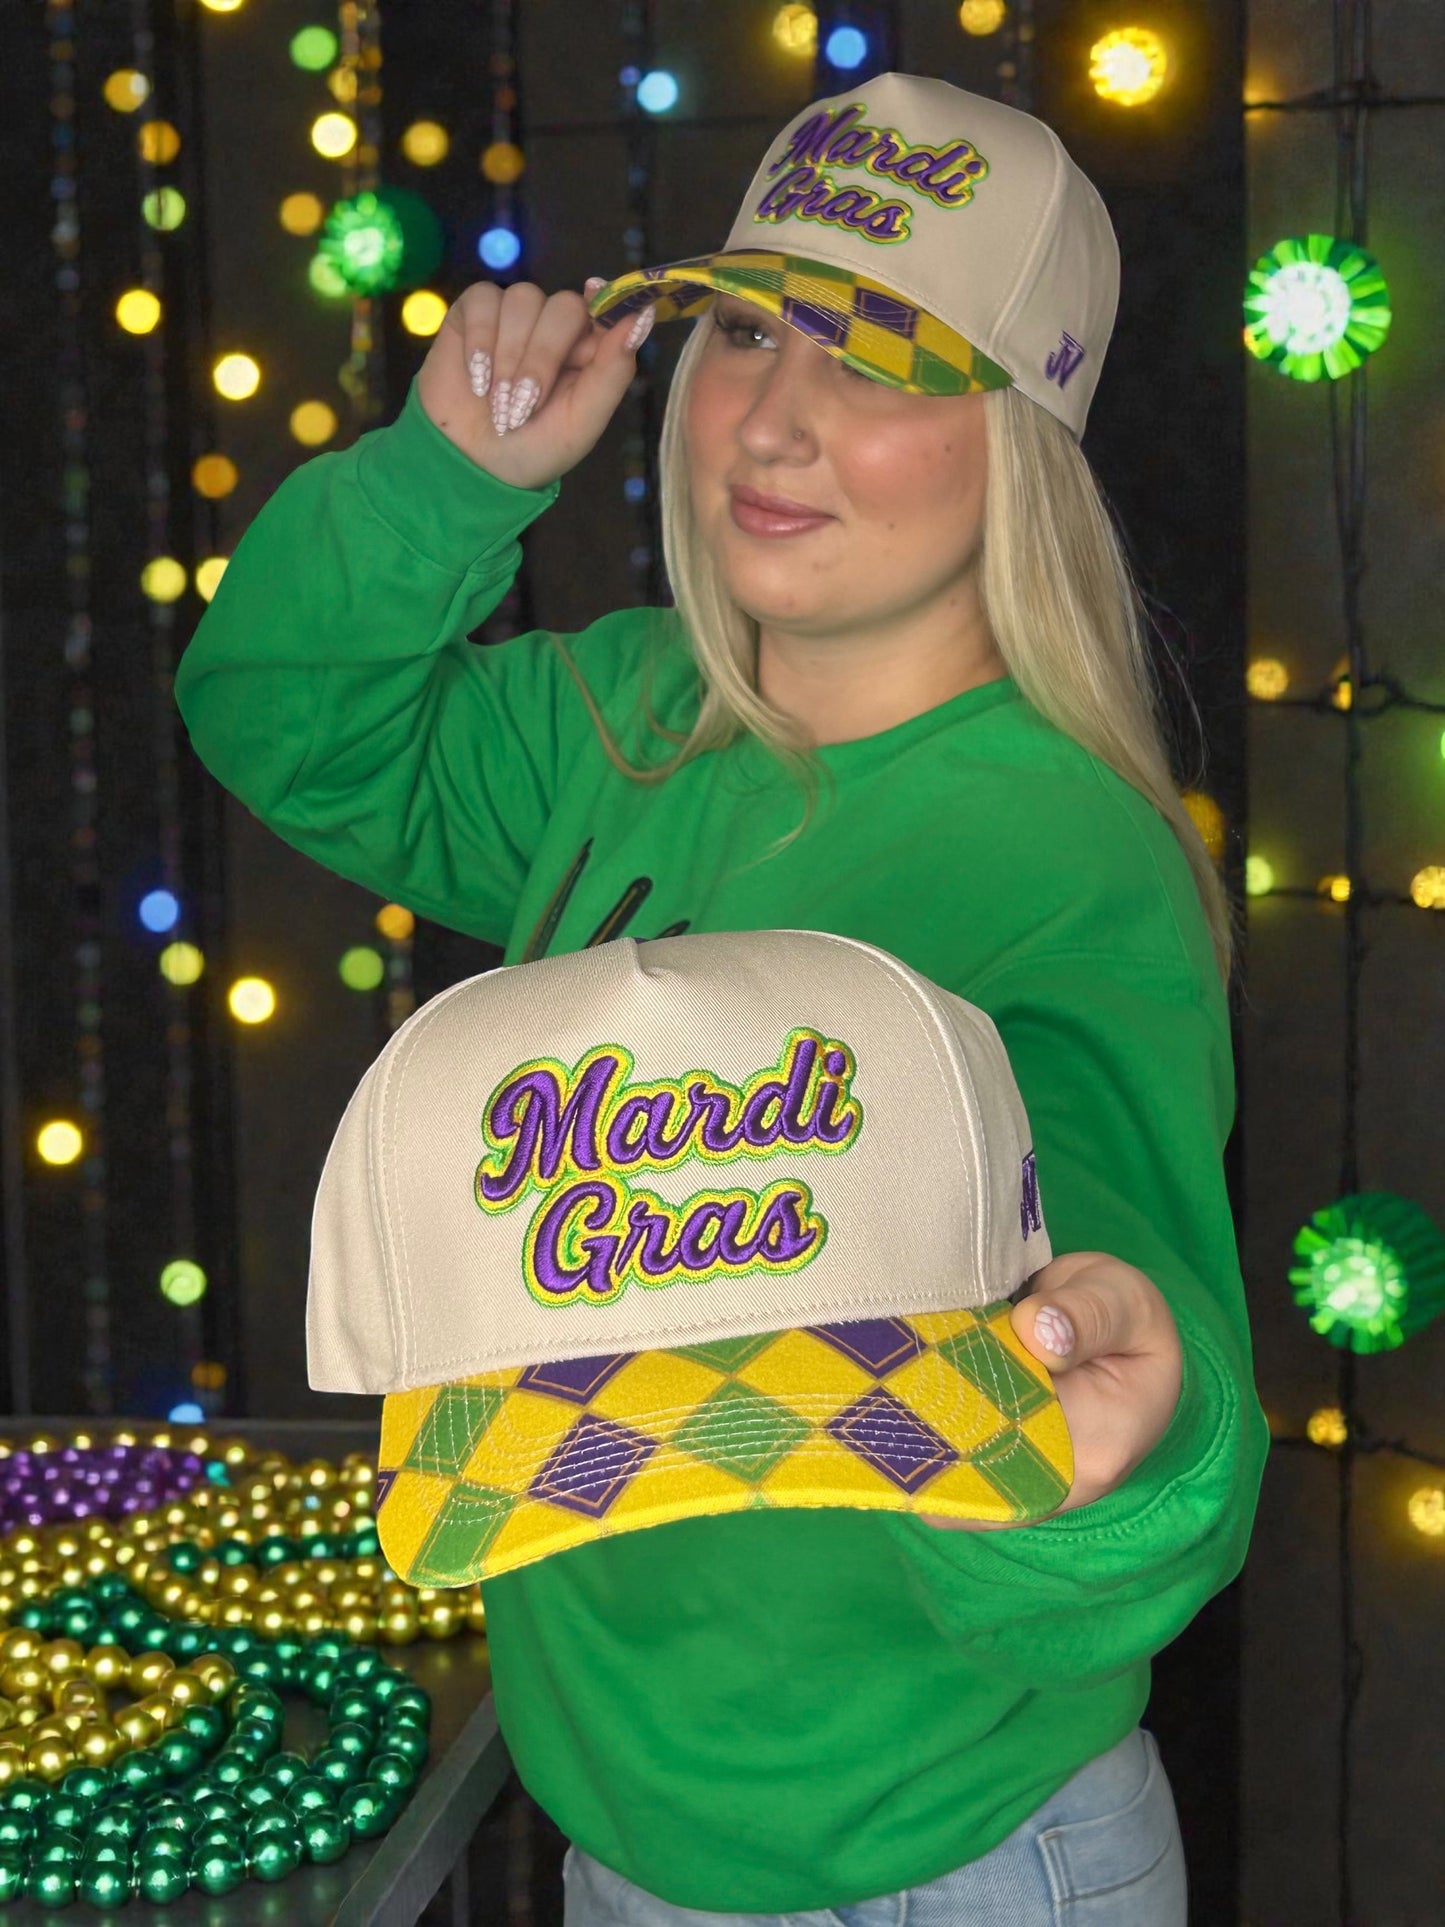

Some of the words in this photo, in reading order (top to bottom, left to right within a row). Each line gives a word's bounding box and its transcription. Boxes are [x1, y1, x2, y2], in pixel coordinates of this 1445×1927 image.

[756, 165, 911, 241] Gras
[767, 105, 986, 206] Mardi
[478, 1033, 859, 1208] Mardi
[528, 1177, 823, 1301] Gras
